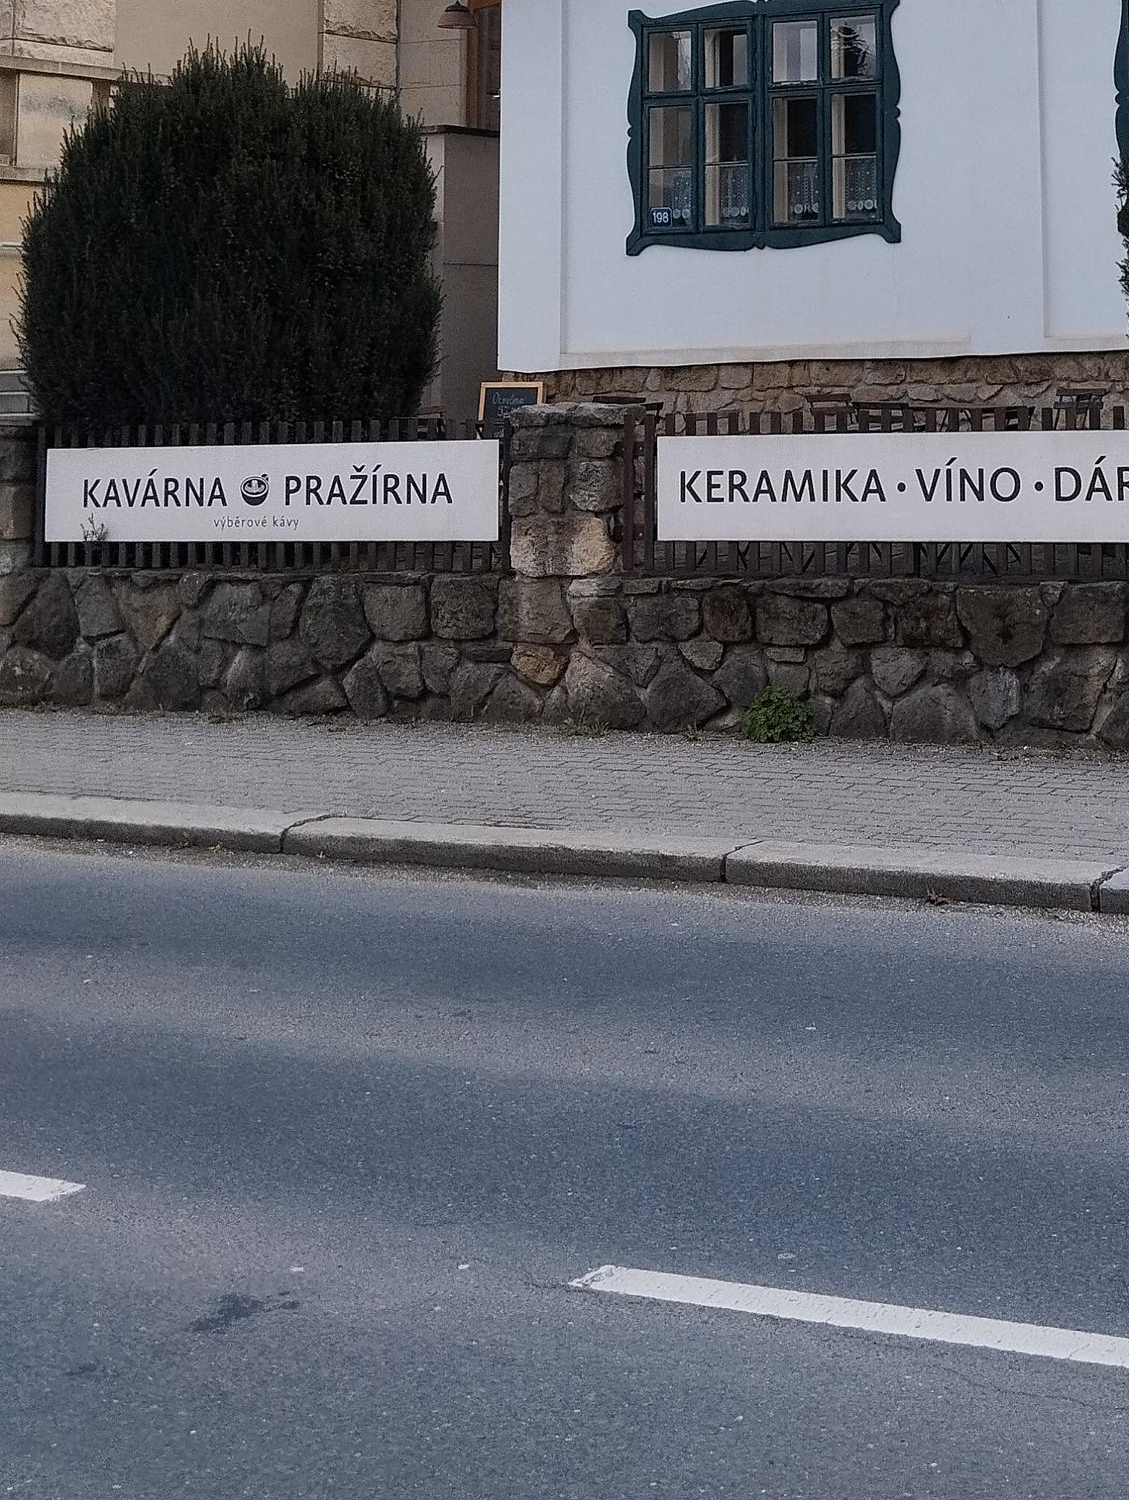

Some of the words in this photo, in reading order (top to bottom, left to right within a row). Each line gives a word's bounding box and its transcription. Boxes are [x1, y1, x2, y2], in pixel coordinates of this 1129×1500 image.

[652, 211, 669, 224] 198
[83, 468, 228, 508] KAVÁRNA
[284, 464, 453, 506] PRAŽÍRNA
[680, 468, 887, 503] KERAMIKA
[915, 457, 1021, 502] VÍNO
[272, 515, 300, 531] kávy
